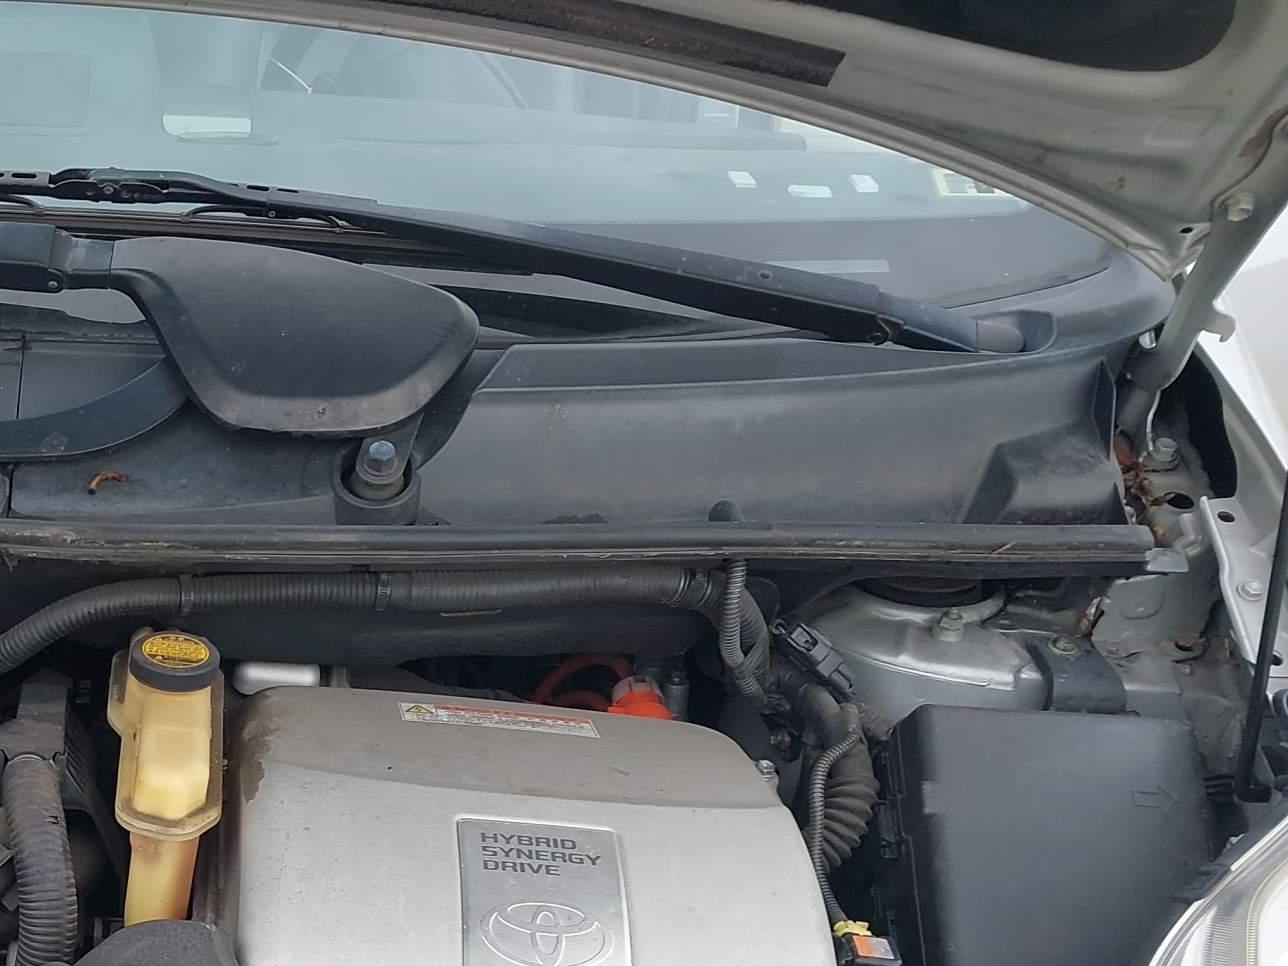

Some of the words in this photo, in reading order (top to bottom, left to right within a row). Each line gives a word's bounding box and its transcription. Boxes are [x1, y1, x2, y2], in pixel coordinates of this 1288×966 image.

[480, 832, 577, 850] HYBRID
[481, 845, 601, 867] SYNERGY
[482, 860, 561, 877] DRIVE
